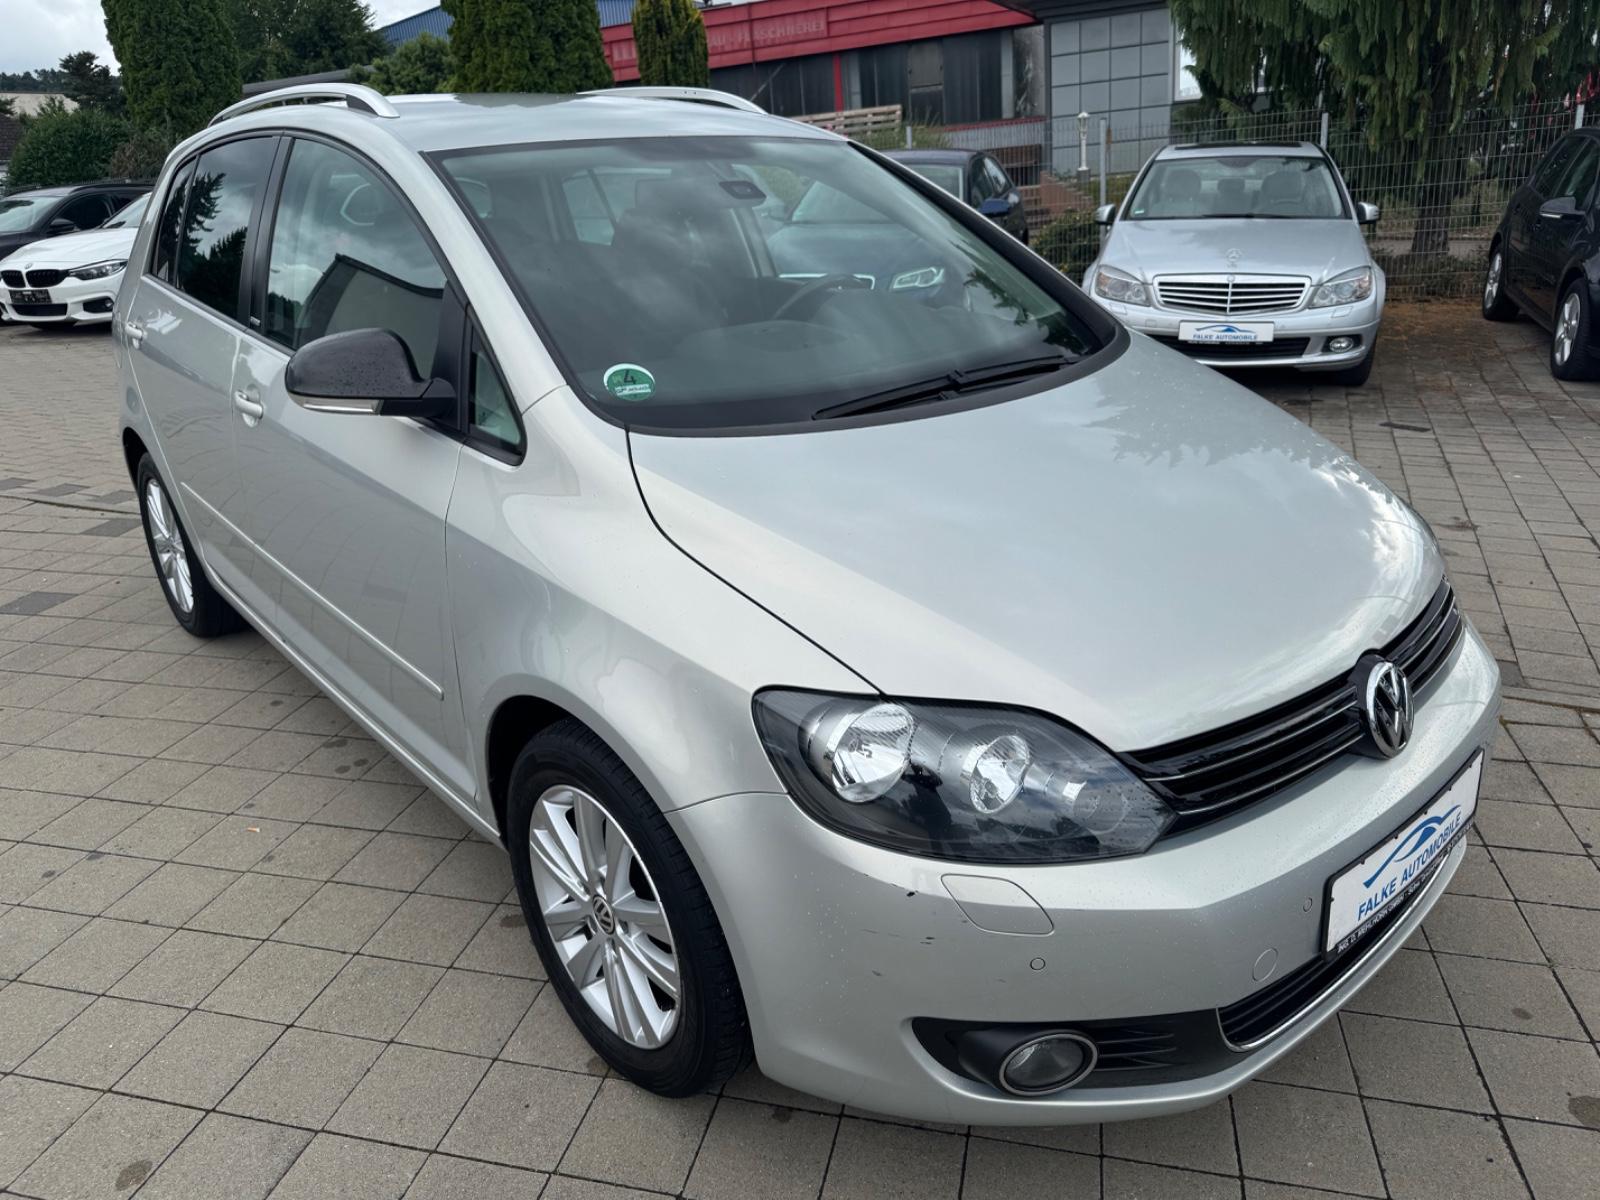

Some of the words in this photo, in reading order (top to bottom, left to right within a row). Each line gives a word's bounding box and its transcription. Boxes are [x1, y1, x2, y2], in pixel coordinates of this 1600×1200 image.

[623, 369, 637, 385] 4
[1357, 877, 1397, 921] FALKE
[1400, 811, 1462, 886] AUTOMOBILE
